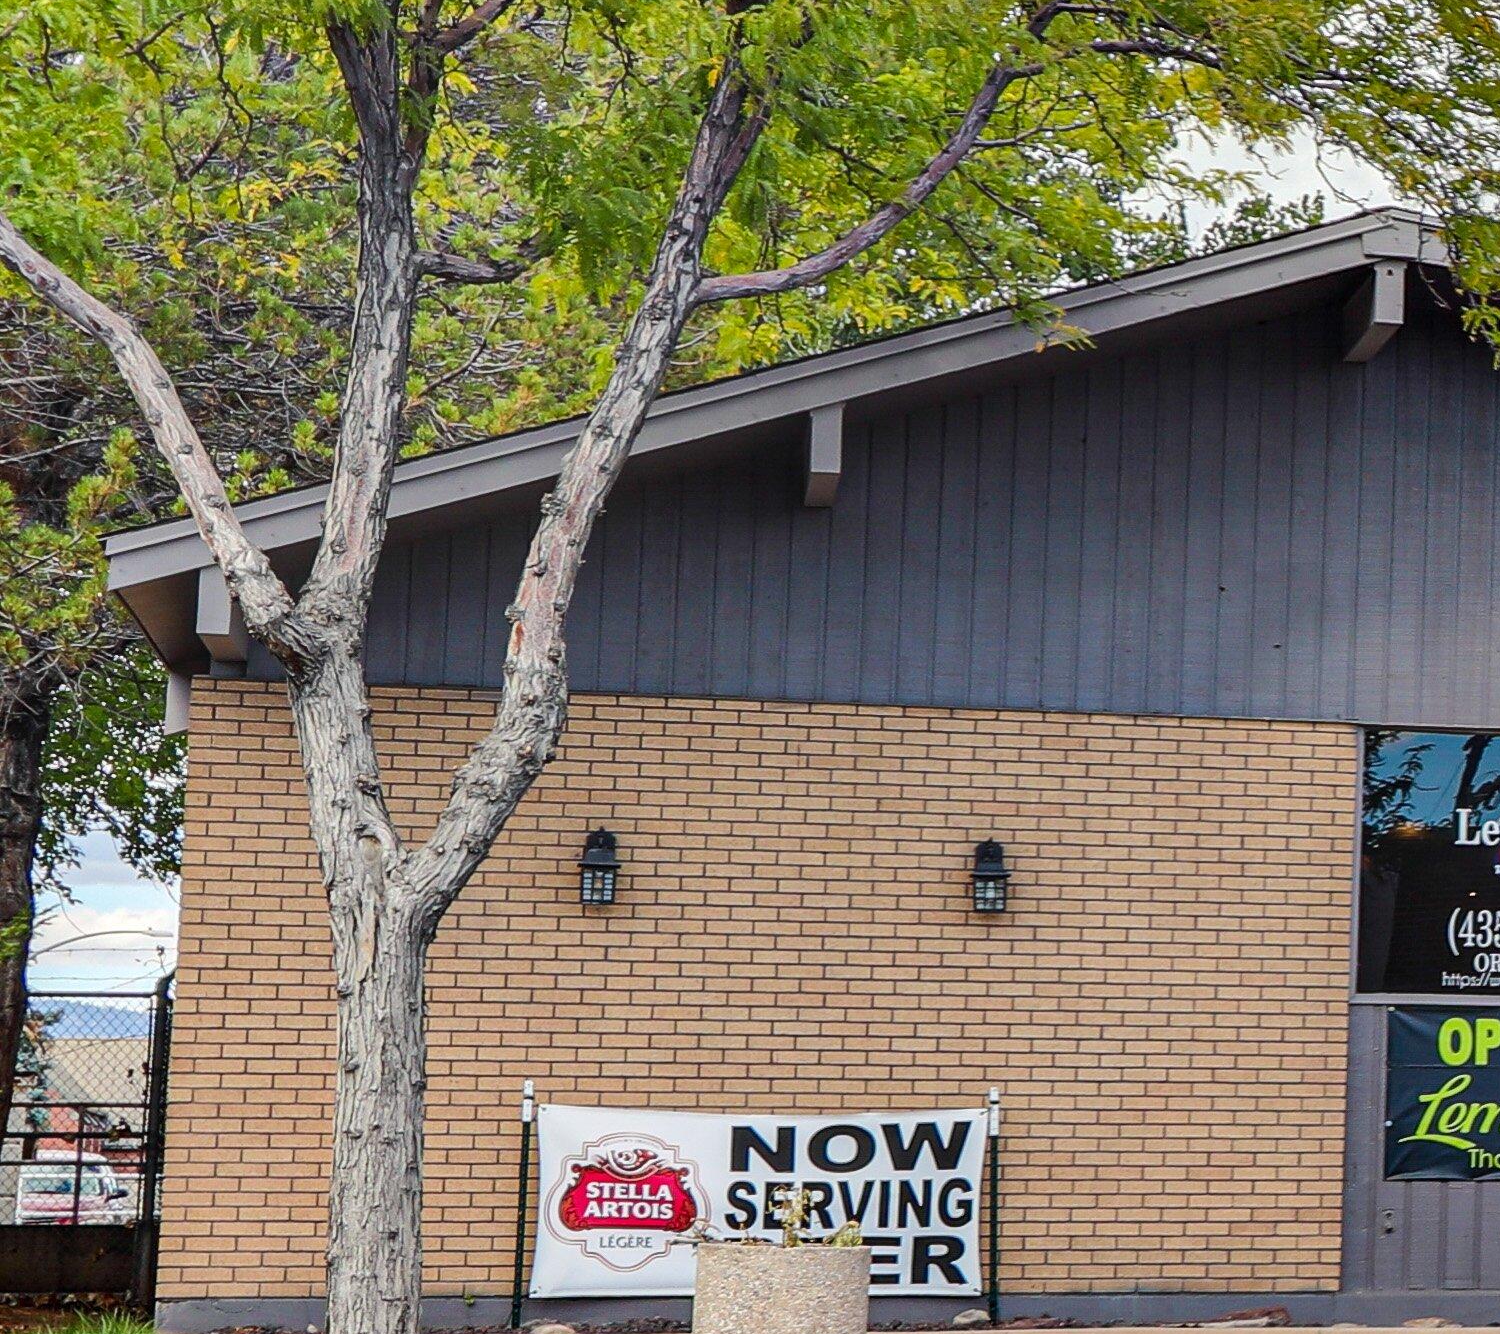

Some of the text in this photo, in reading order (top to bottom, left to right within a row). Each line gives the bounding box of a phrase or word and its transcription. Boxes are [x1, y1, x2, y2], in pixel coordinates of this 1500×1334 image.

[729, 1121, 973, 1173] NOW
[585, 1181, 674, 1201] STELLA
[583, 1201, 674, 1220] ARTOIS
[724, 1175, 975, 1230] SERVING
[599, 1233, 653, 1250] LÉGÈRE
